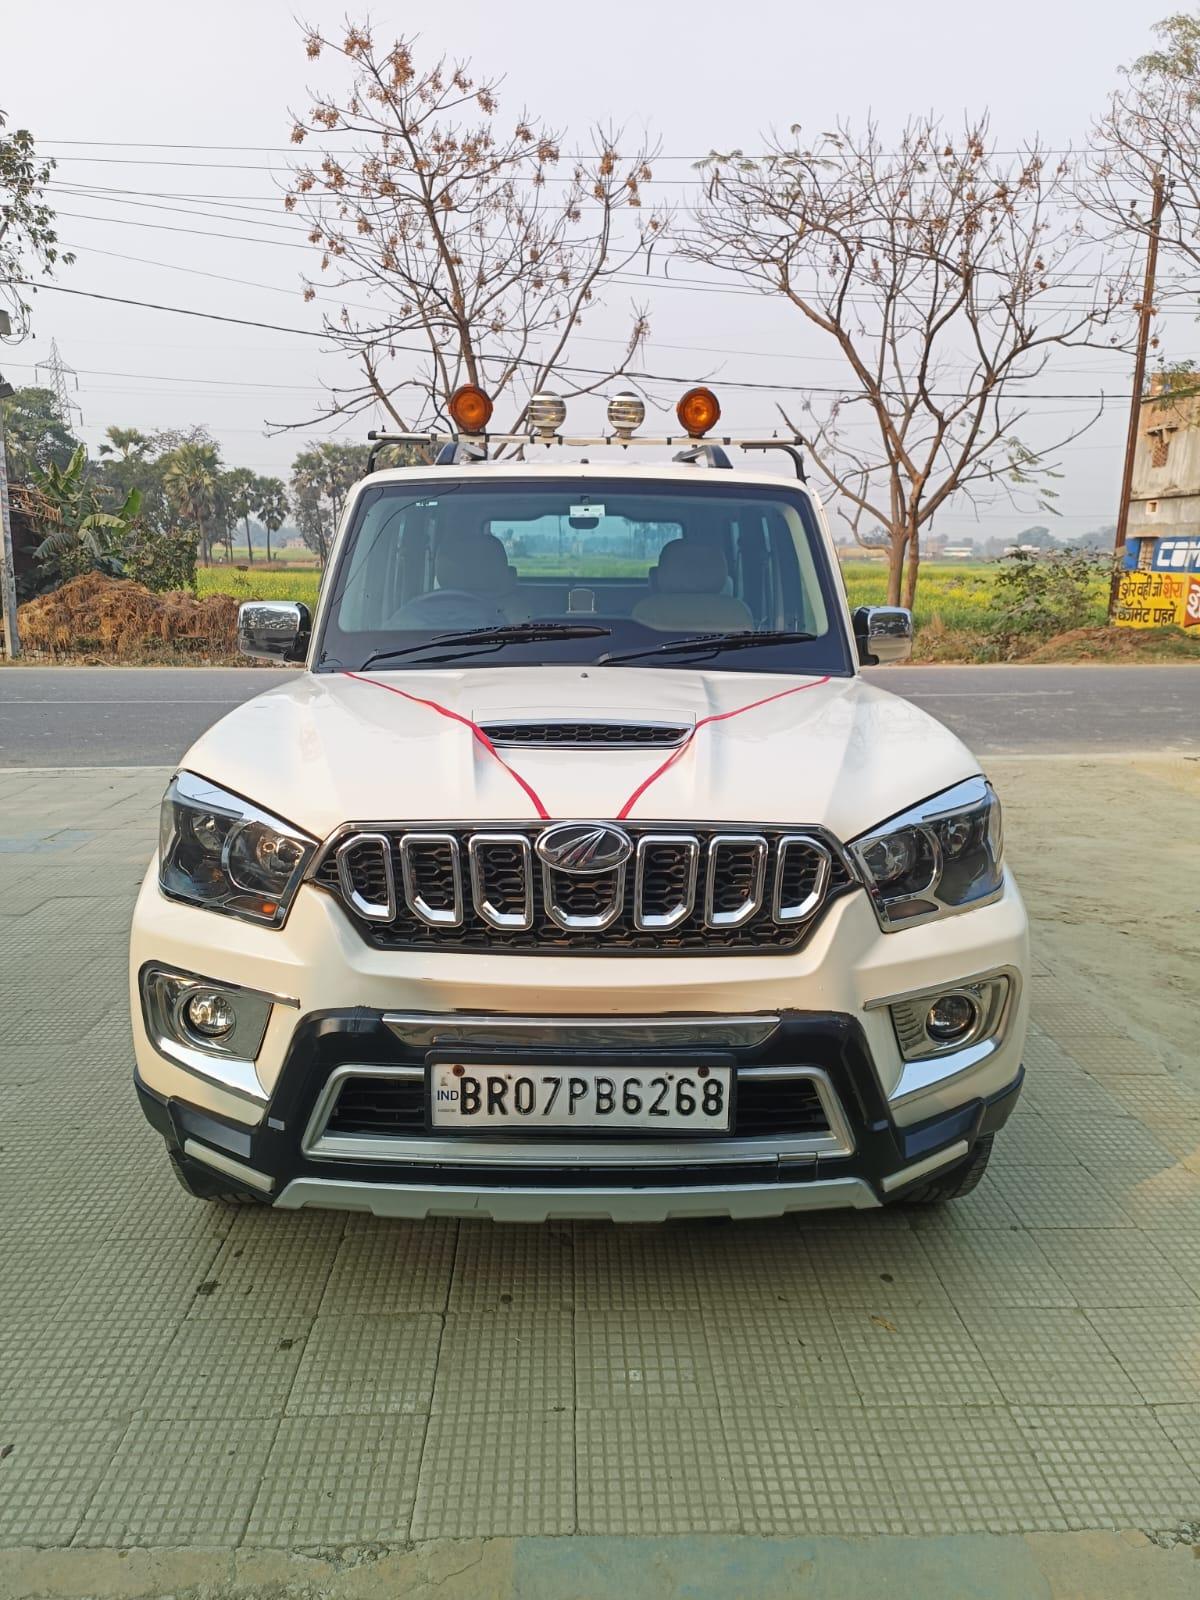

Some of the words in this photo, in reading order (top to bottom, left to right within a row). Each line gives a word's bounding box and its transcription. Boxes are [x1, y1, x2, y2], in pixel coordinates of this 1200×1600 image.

[1152, 574, 1163, 598] जो
[437, 1090, 459, 1101] IND
[460, 1076, 723, 1116] BR07PB6268
